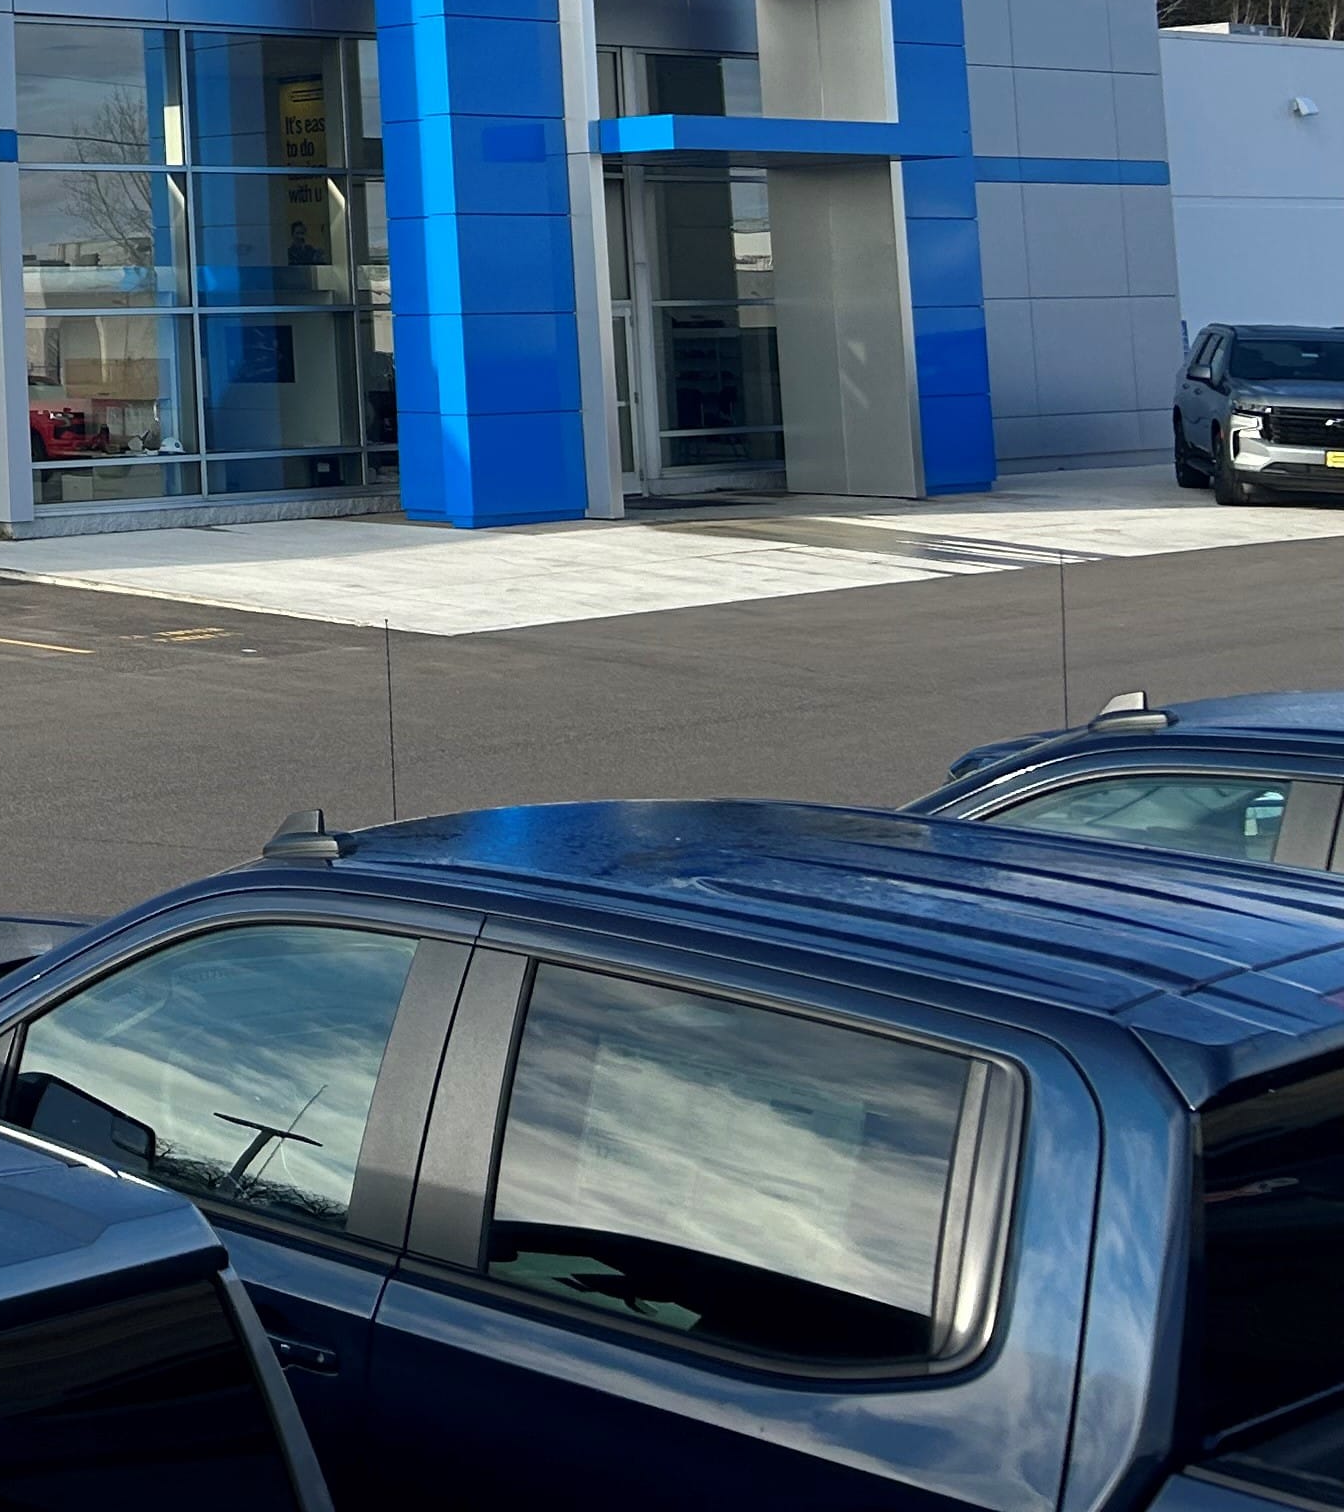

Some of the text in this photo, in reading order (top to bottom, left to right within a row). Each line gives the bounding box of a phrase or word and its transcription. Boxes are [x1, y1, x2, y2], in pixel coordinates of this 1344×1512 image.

[305, 117, 325, 133] eas
[287, 140, 315, 158] to do
